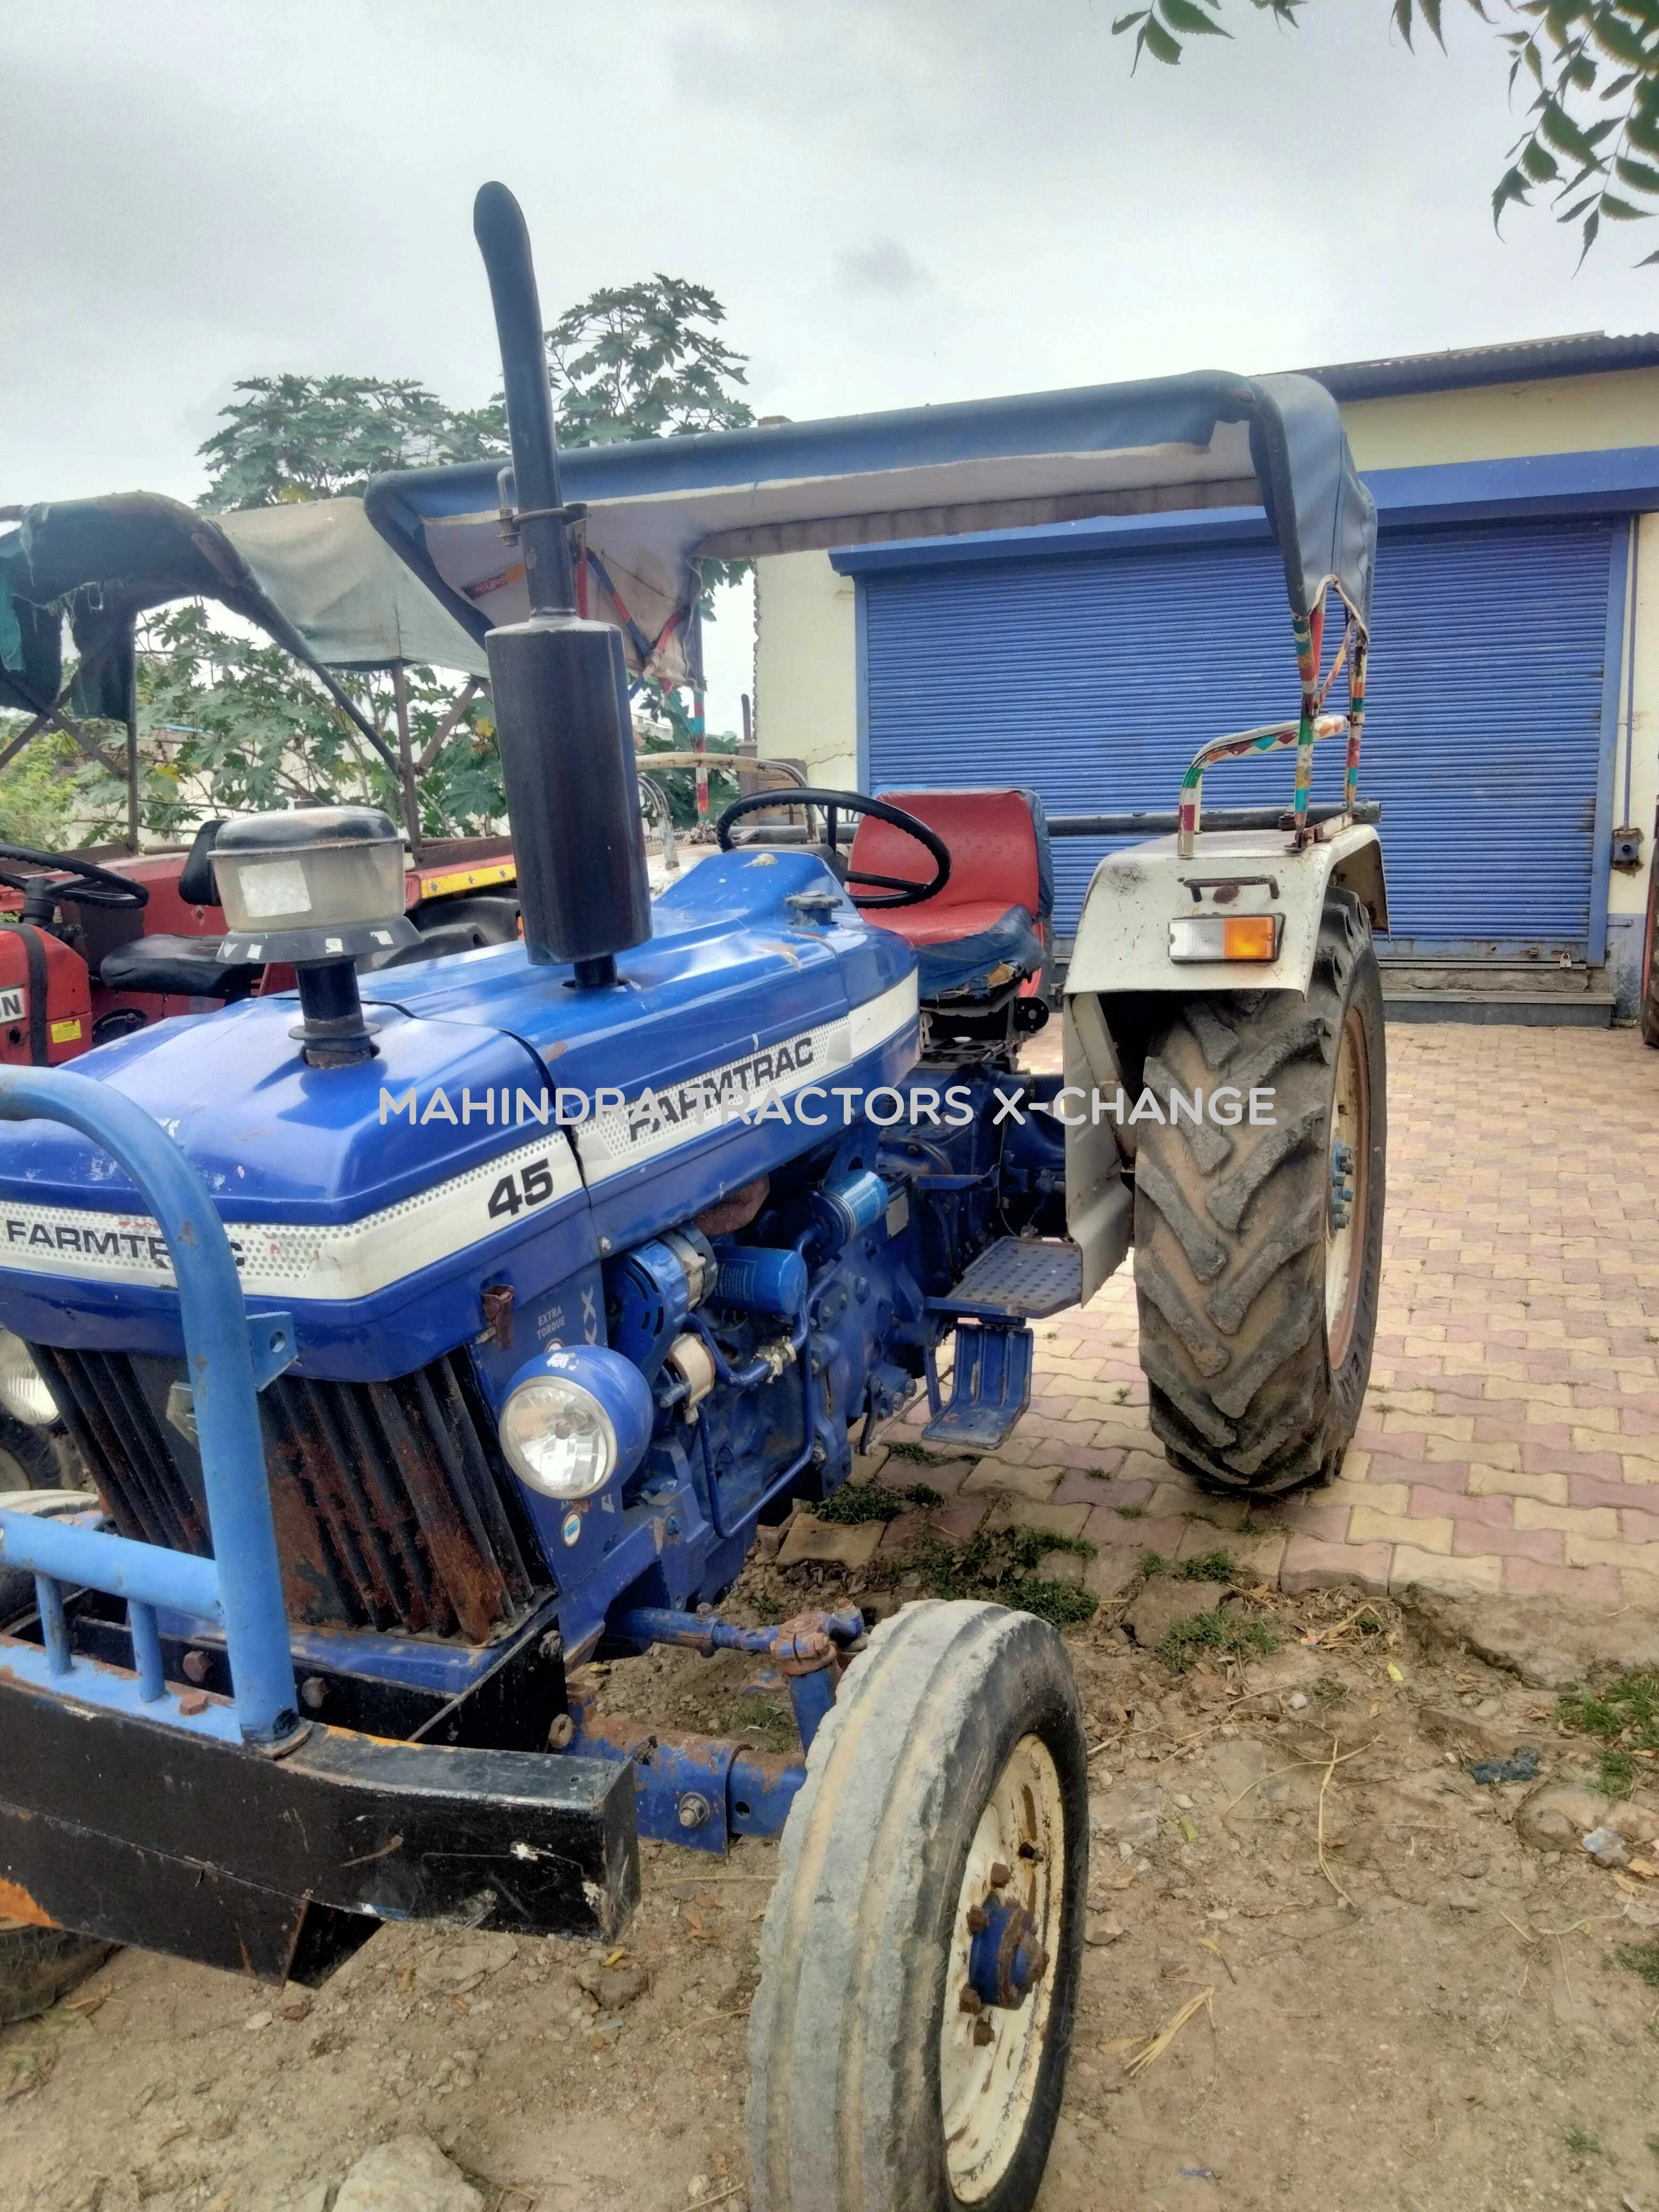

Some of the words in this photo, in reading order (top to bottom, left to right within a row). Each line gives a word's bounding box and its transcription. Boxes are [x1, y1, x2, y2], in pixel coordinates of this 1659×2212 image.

[627, 1036, 814, 1142] FARMTRAC
[488, 1158, 554, 1219] 45
[6, 1219, 246, 1270] FARMTRC
[537, 1316, 566, 1340] TORQUE
[538, 1305, 563, 1327] EXTRA
